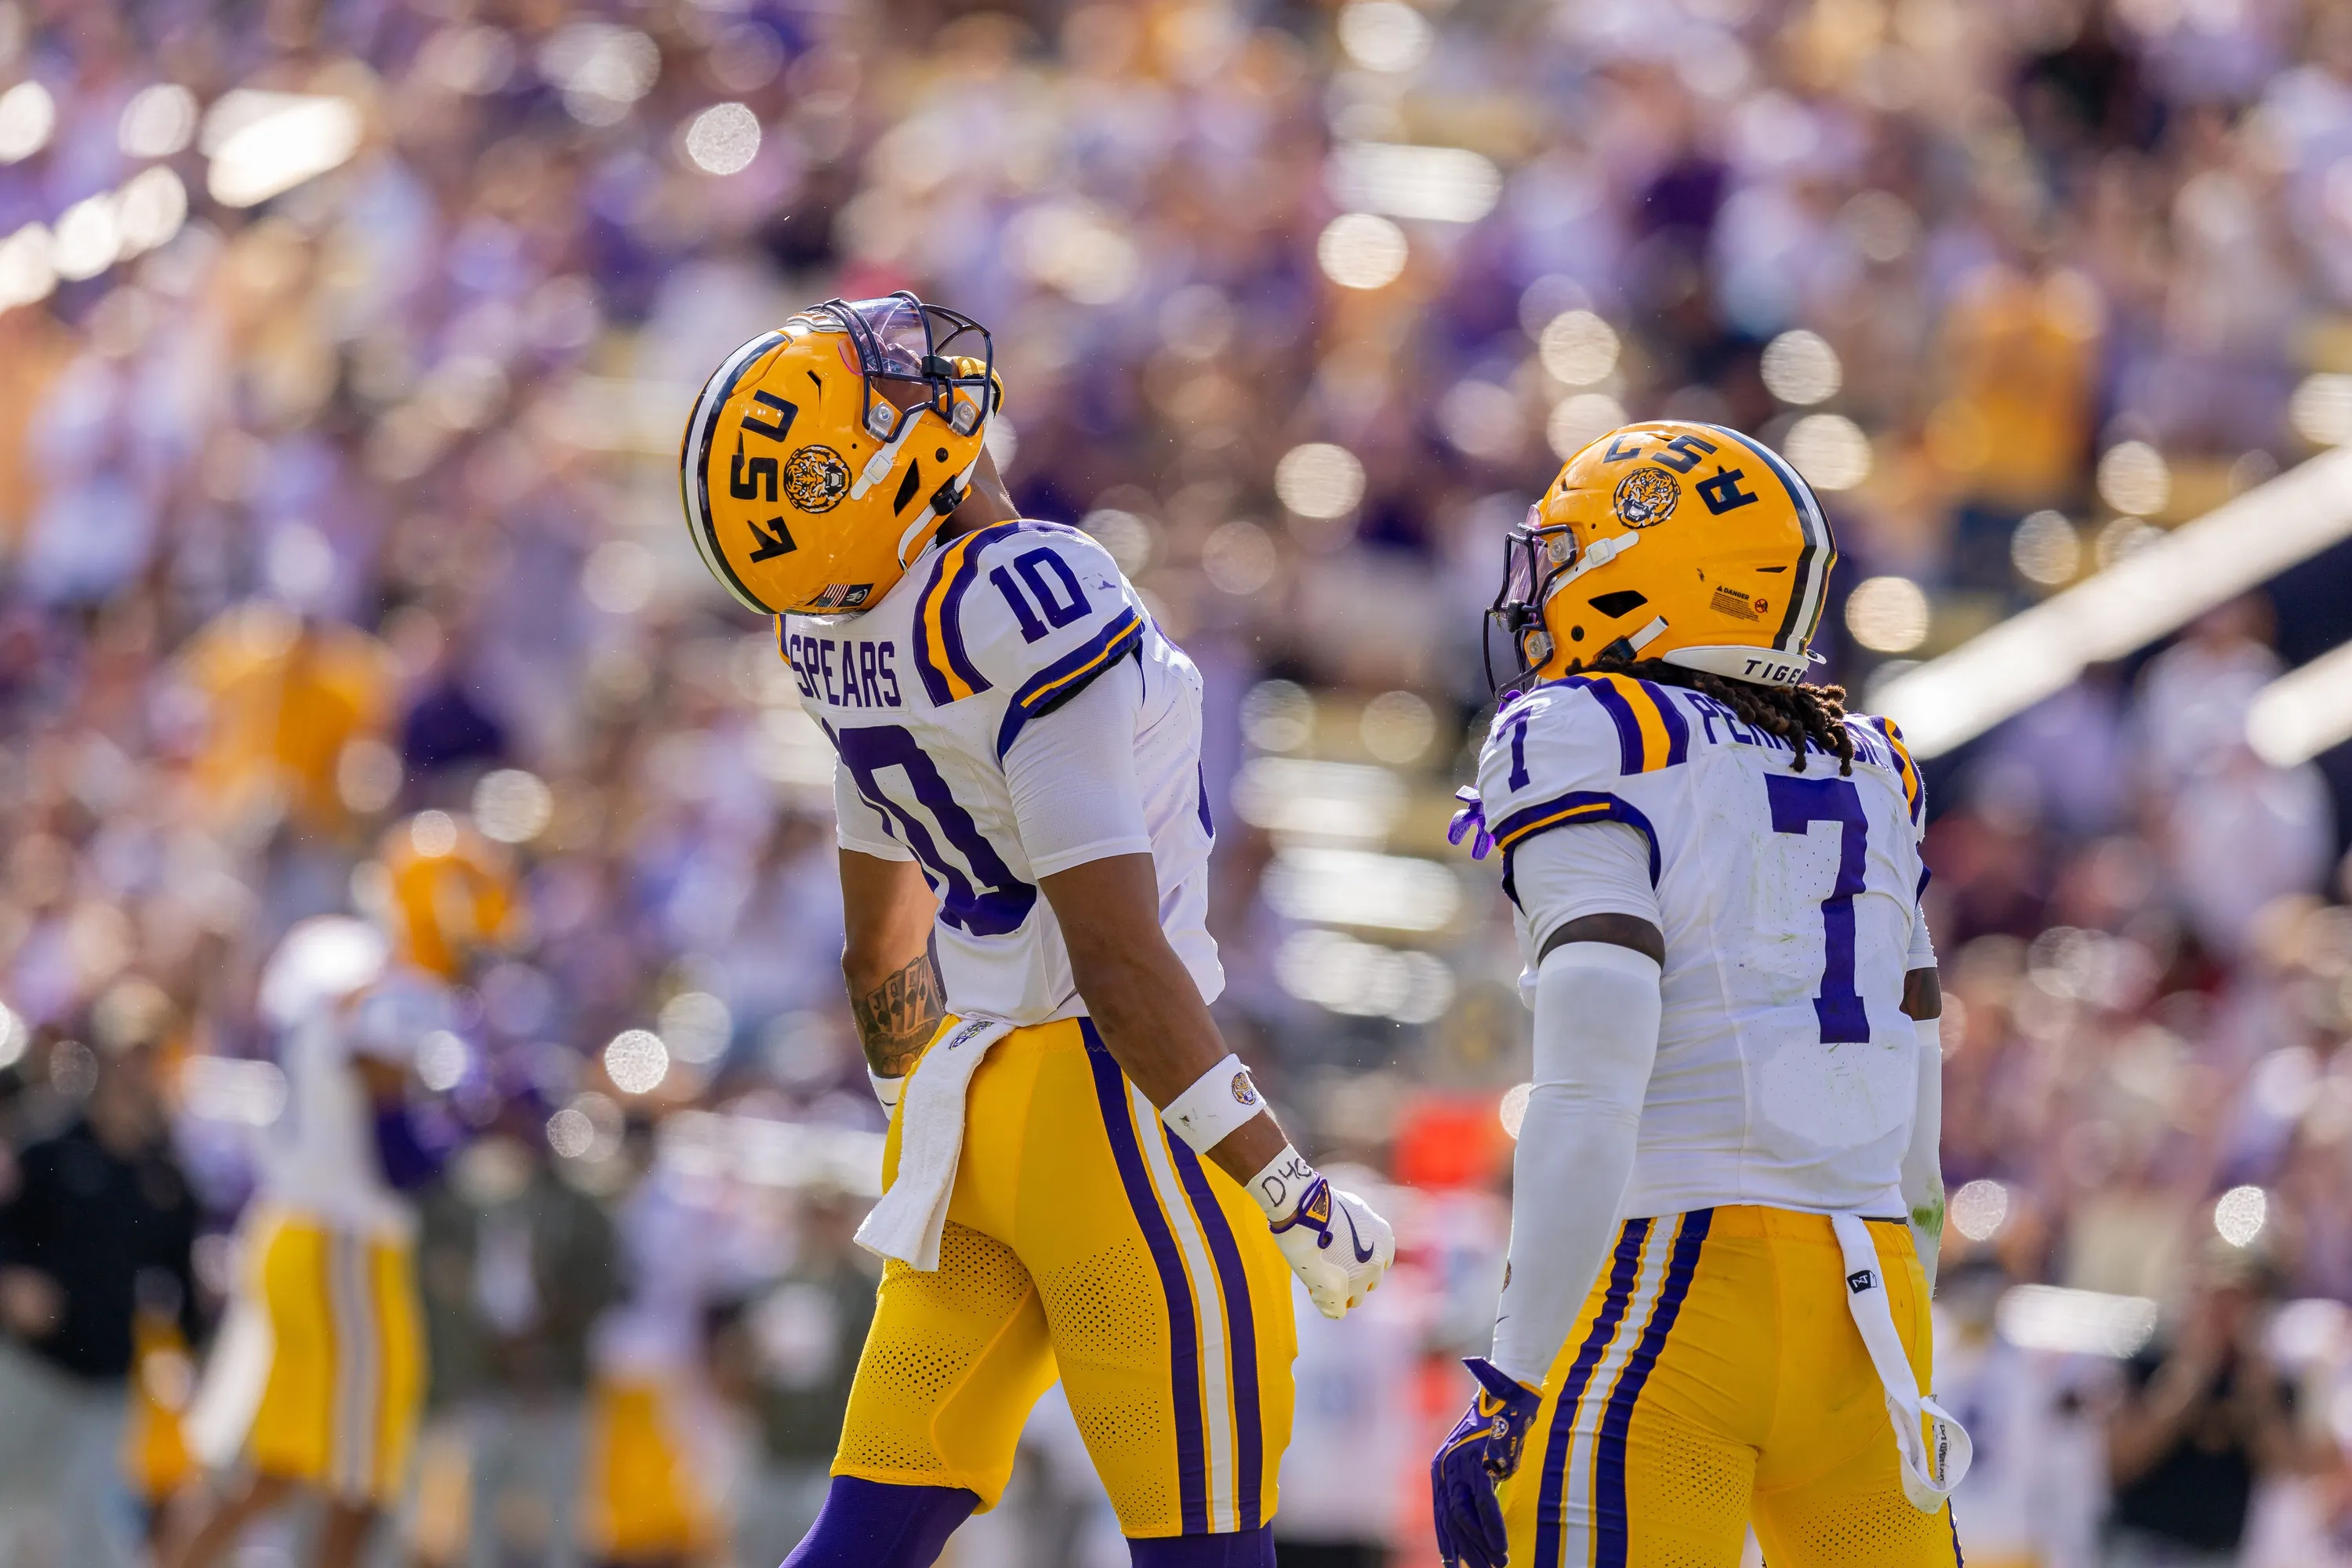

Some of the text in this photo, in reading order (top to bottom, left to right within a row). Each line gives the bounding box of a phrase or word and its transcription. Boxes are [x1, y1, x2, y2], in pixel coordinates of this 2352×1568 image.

[989, 546, 1092, 644] 10
[1723, 587, 1750, 601] DANGER
[790, 634, 902, 708] SPEARS
[1496, 705, 1533, 793] 7
[1763, 771, 1871, 1044] 7
